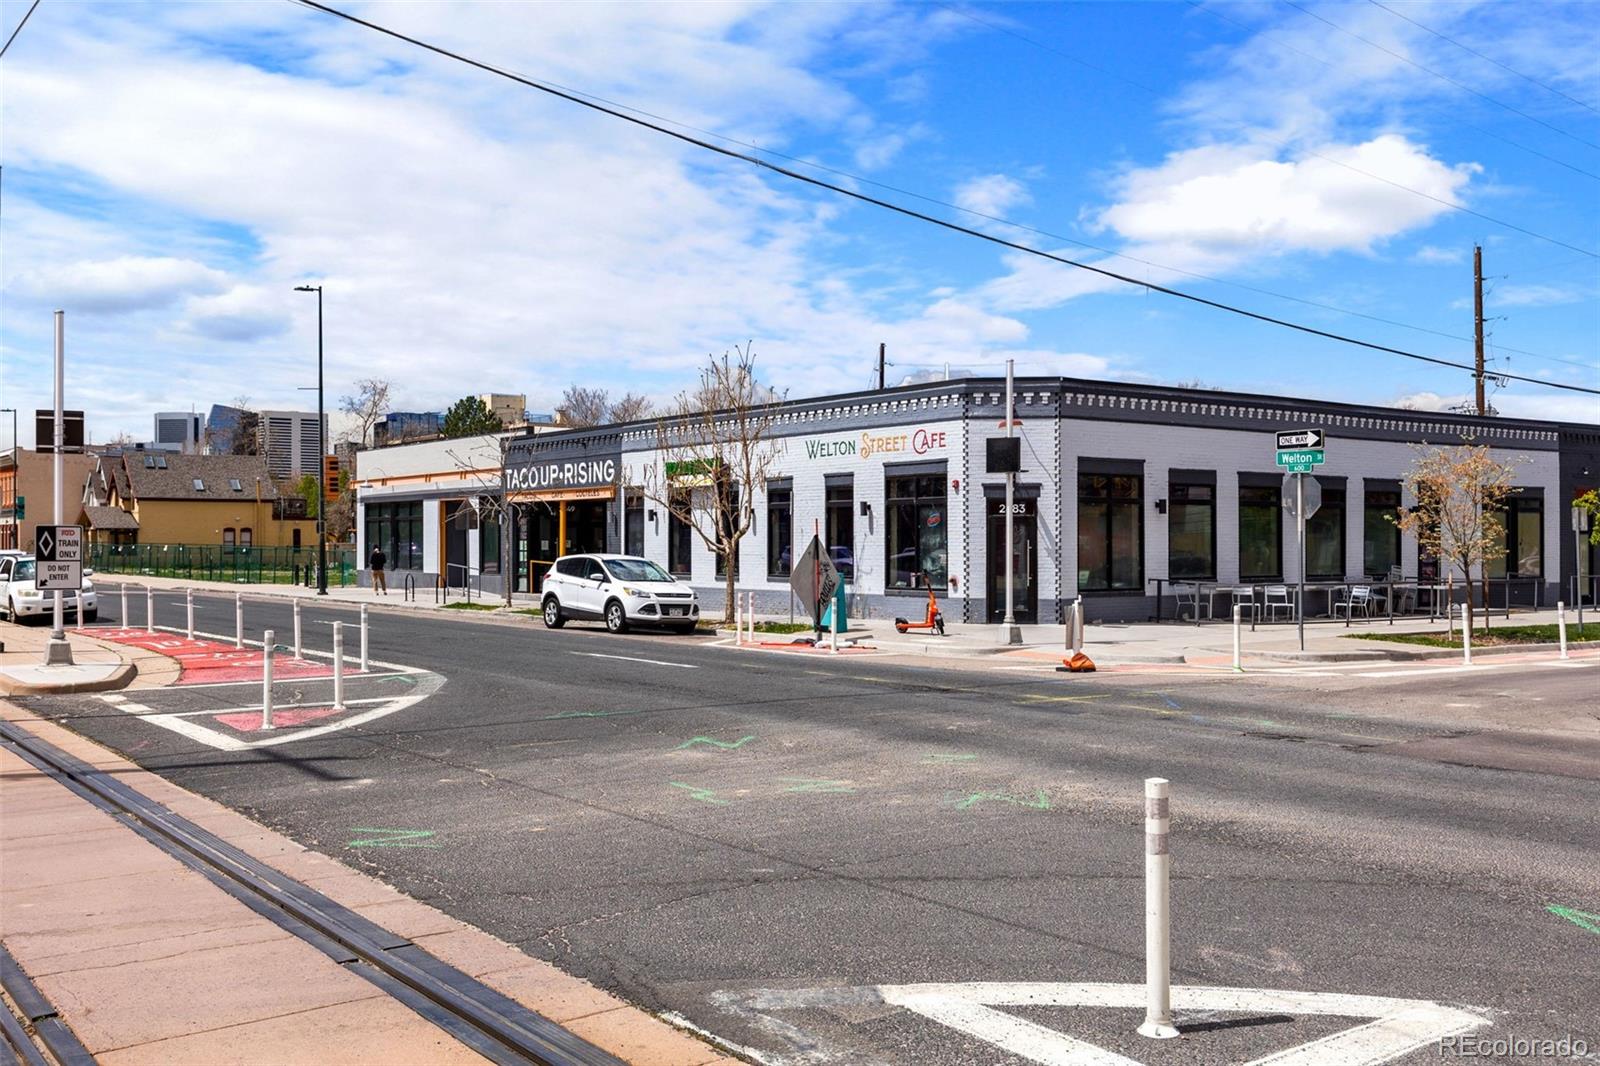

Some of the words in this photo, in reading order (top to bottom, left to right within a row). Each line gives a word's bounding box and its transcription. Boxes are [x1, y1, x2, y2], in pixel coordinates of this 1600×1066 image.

[805, 439, 856, 460] WELTON
[860, 432, 907, 459] STREET
[912, 429, 946, 455] CAFE
[1281, 453, 1313, 463] Welton
[505, 466, 538, 489] TACO
[999, 504, 1026, 514] 283
